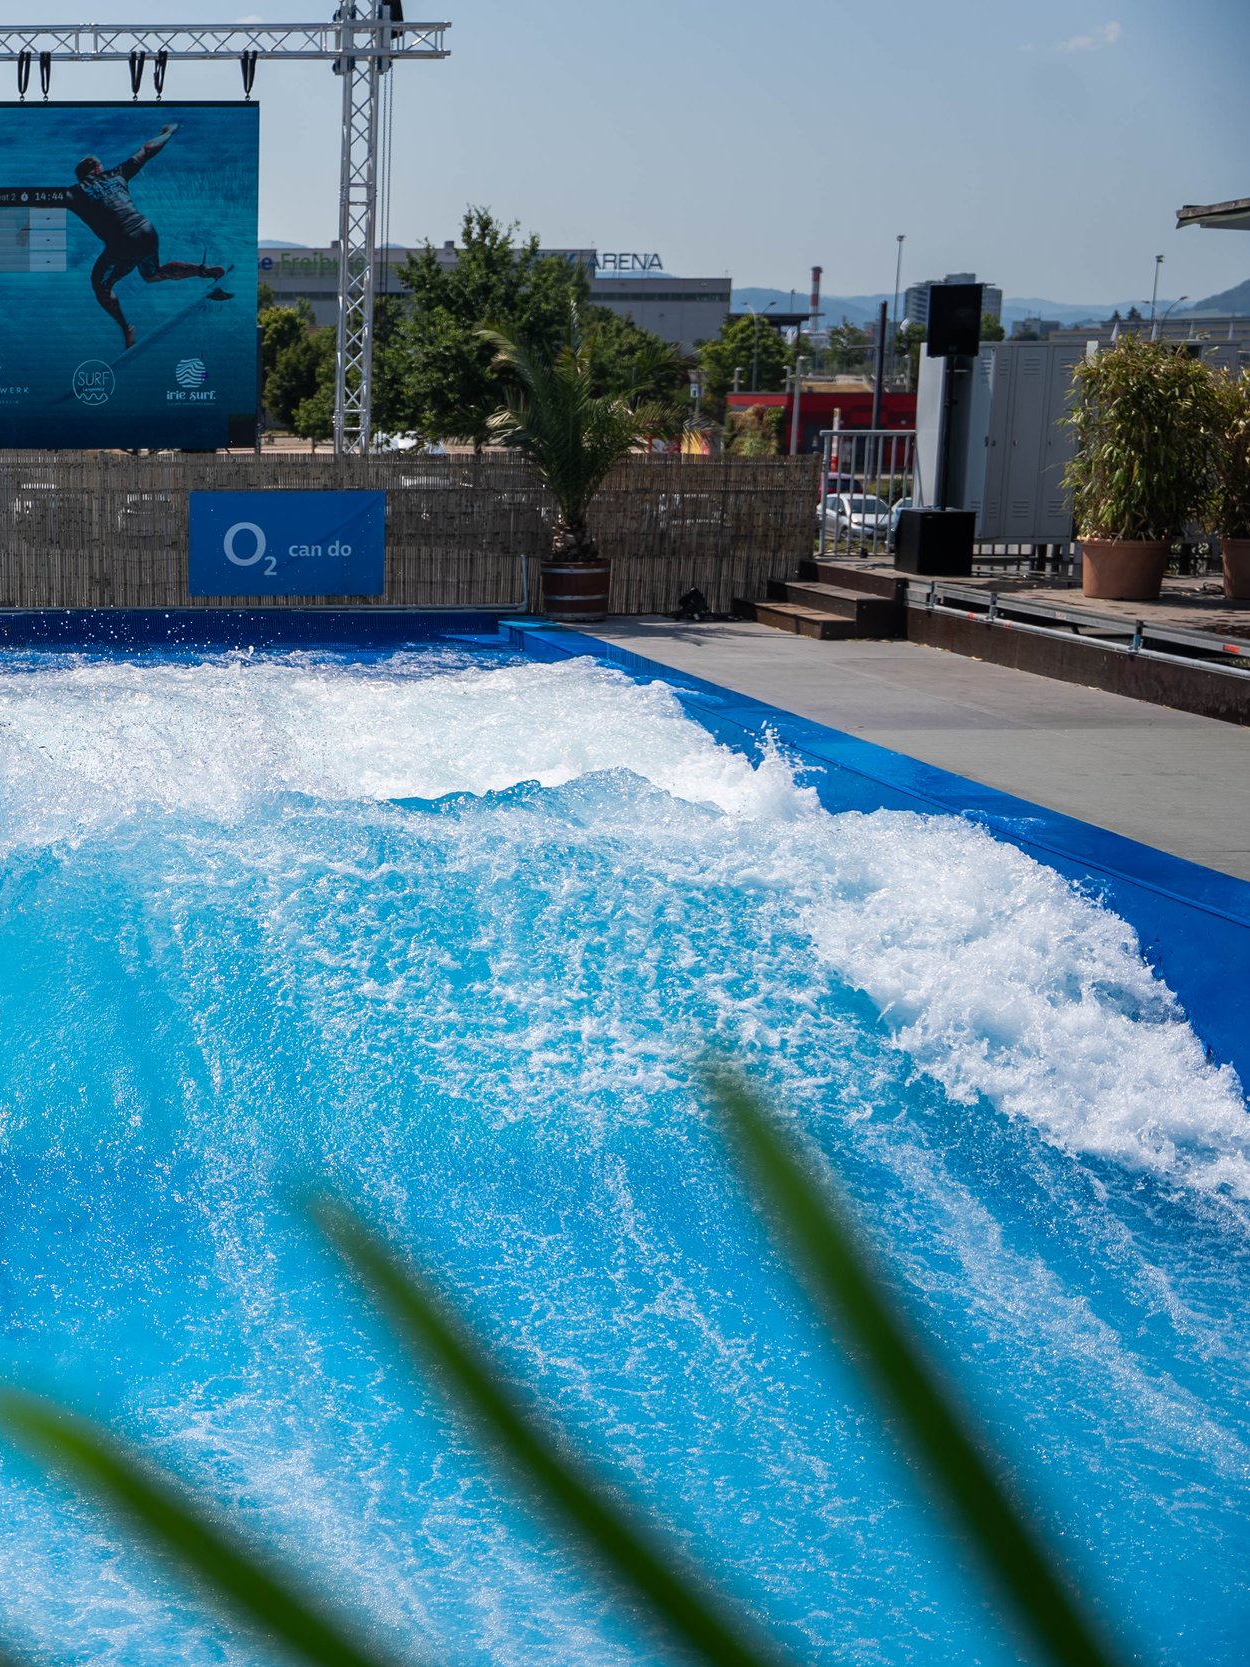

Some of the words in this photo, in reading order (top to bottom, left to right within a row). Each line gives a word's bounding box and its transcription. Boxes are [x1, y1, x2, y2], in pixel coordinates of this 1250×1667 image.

[10, 193, 17, 201] 2
[34, 192, 64, 201] 14:44
[587, 253, 664, 270] ARENA
[77, 371, 110, 387] SURF
[166, 390, 186, 400] irie
[288, 544, 322, 557] can
[327, 540, 352, 557] do
